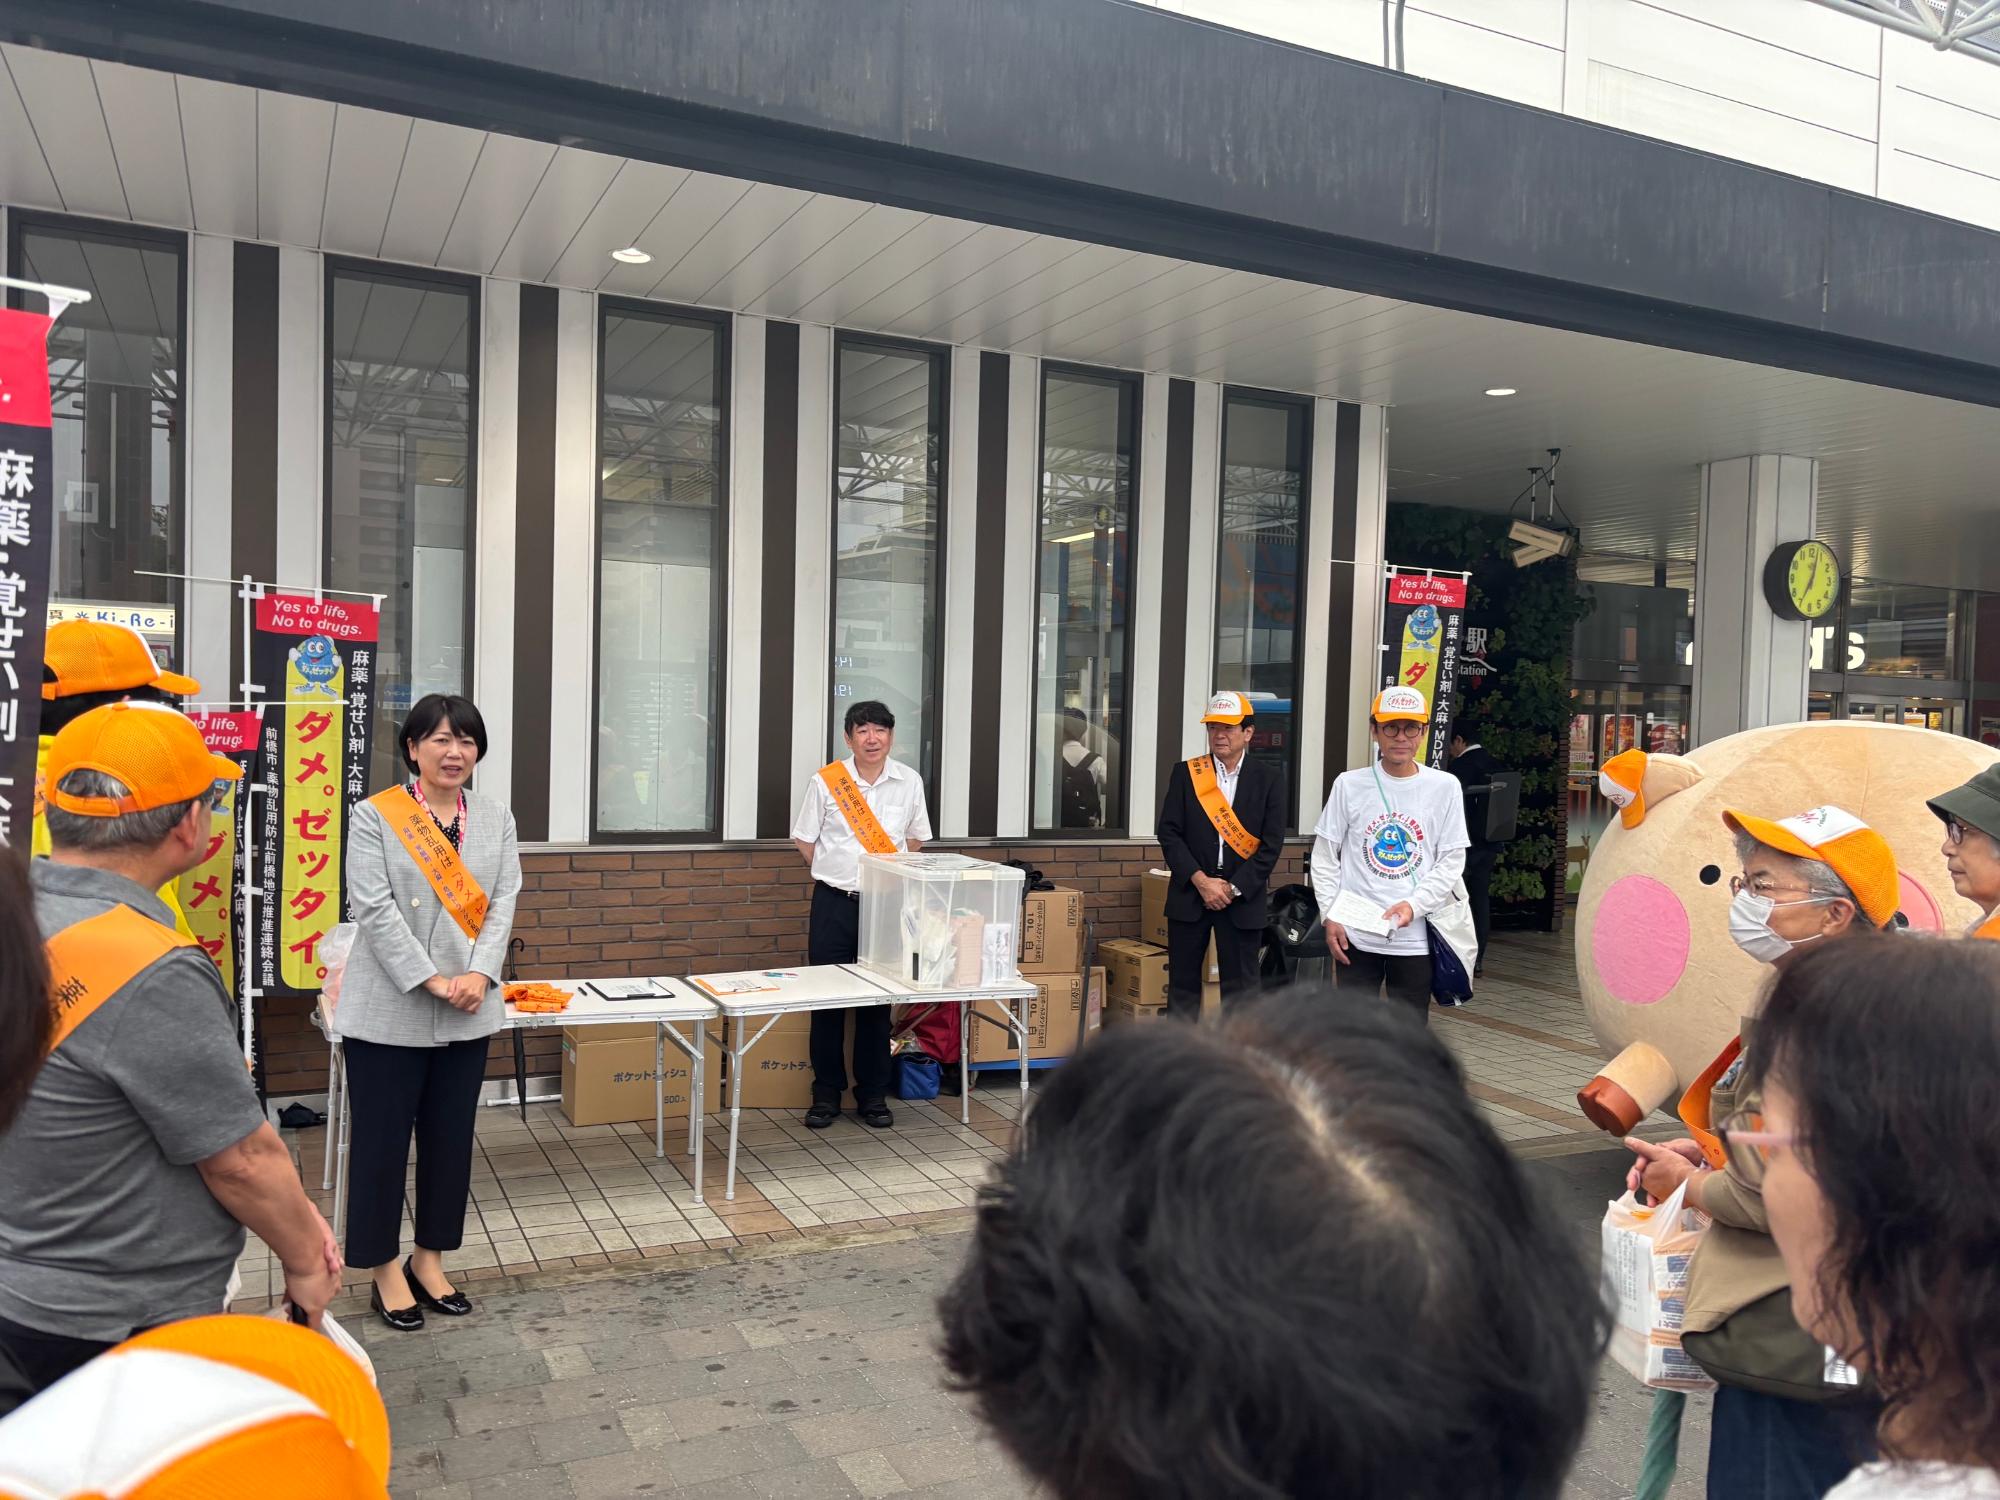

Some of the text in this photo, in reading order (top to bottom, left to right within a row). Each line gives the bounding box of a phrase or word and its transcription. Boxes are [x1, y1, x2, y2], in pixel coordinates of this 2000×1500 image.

[1400, 579, 1417, 590] Yes
[1431, 580, 1448, 592] life,
[1398, 589, 1456, 604] No to drugs.
[273, 599, 350, 621] Yes to life,
[271, 614, 363, 637] No to drugs.
[1466, 627, 1488, 654] 駅
[1404, 661, 1430, 686] ダ
[1458, 664, 1487, 676] tation
[211, 717, 239, 732] life,
[288, 710, 335, 981] ダメ。ゼッタイ。
[1026, 912, 1034, 932] 10L
